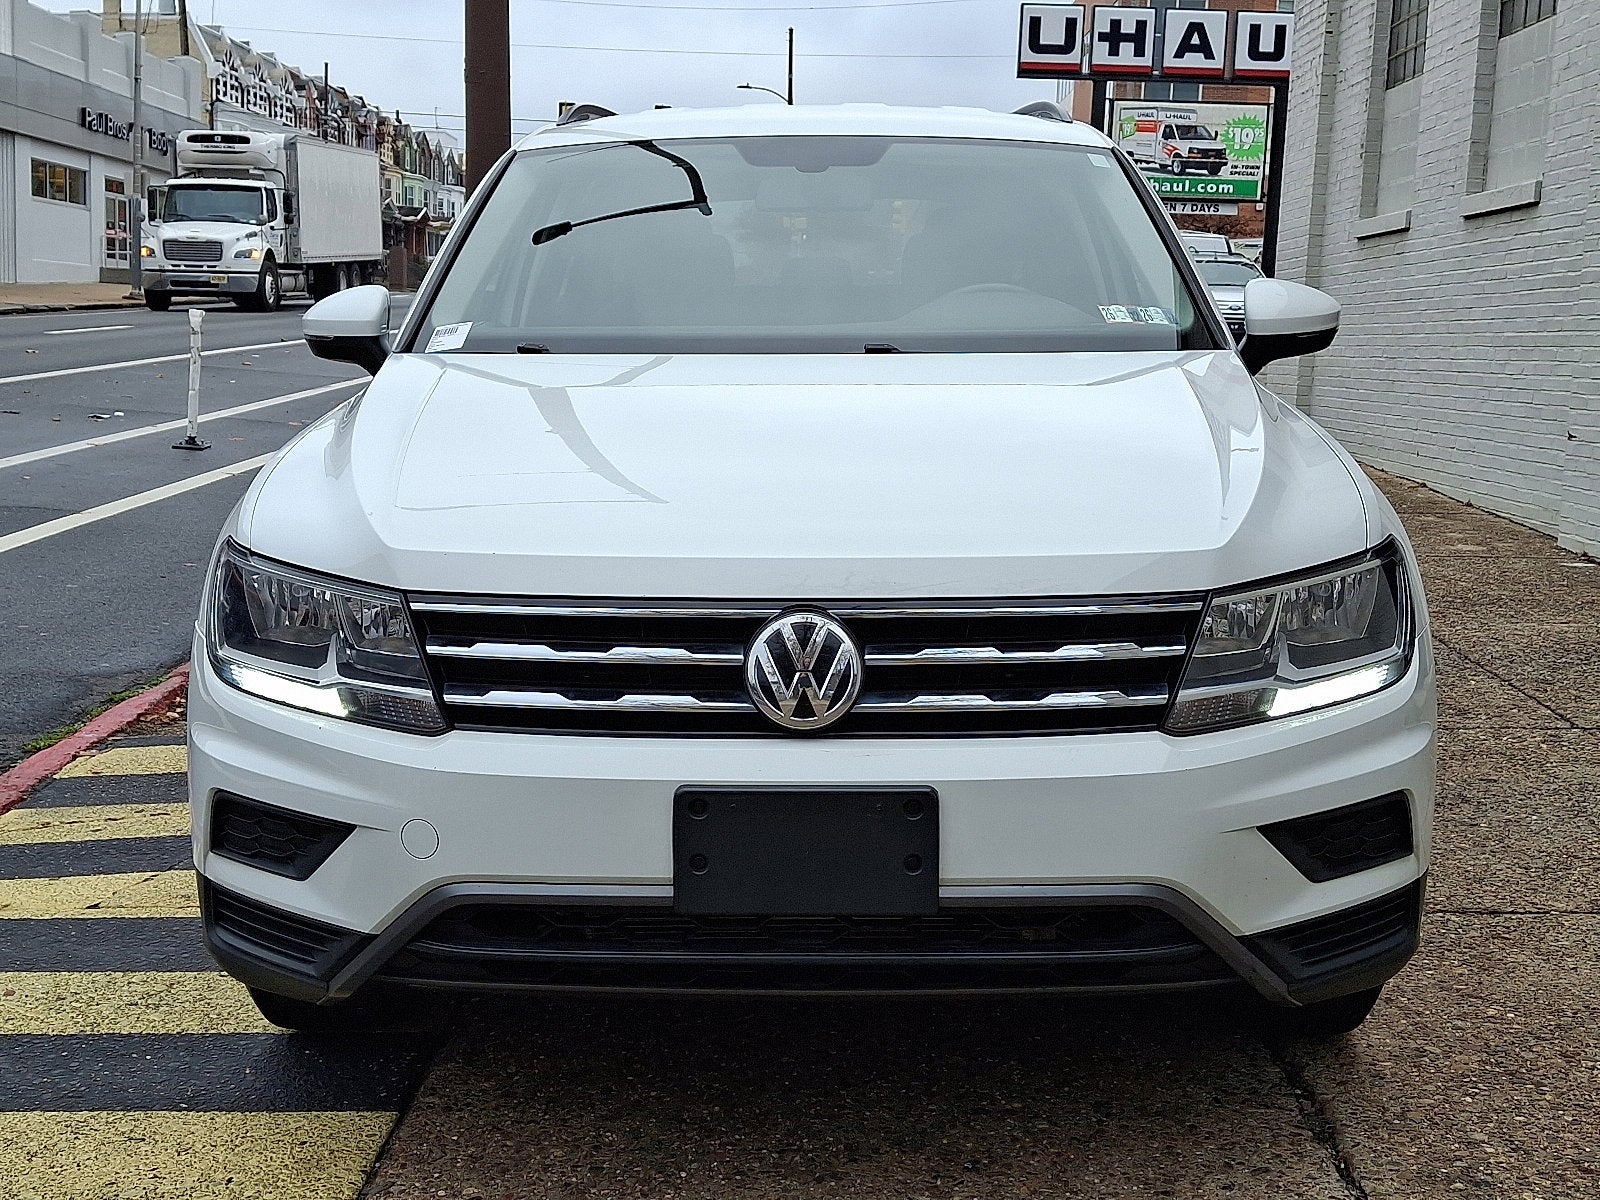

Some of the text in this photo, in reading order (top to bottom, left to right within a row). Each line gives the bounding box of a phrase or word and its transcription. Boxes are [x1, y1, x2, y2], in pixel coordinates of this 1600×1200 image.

[82, 107, 105, 132] Paul
[1181, 203, 1188, 212] 7
[1190, 204, 1220, 213] DAYS
